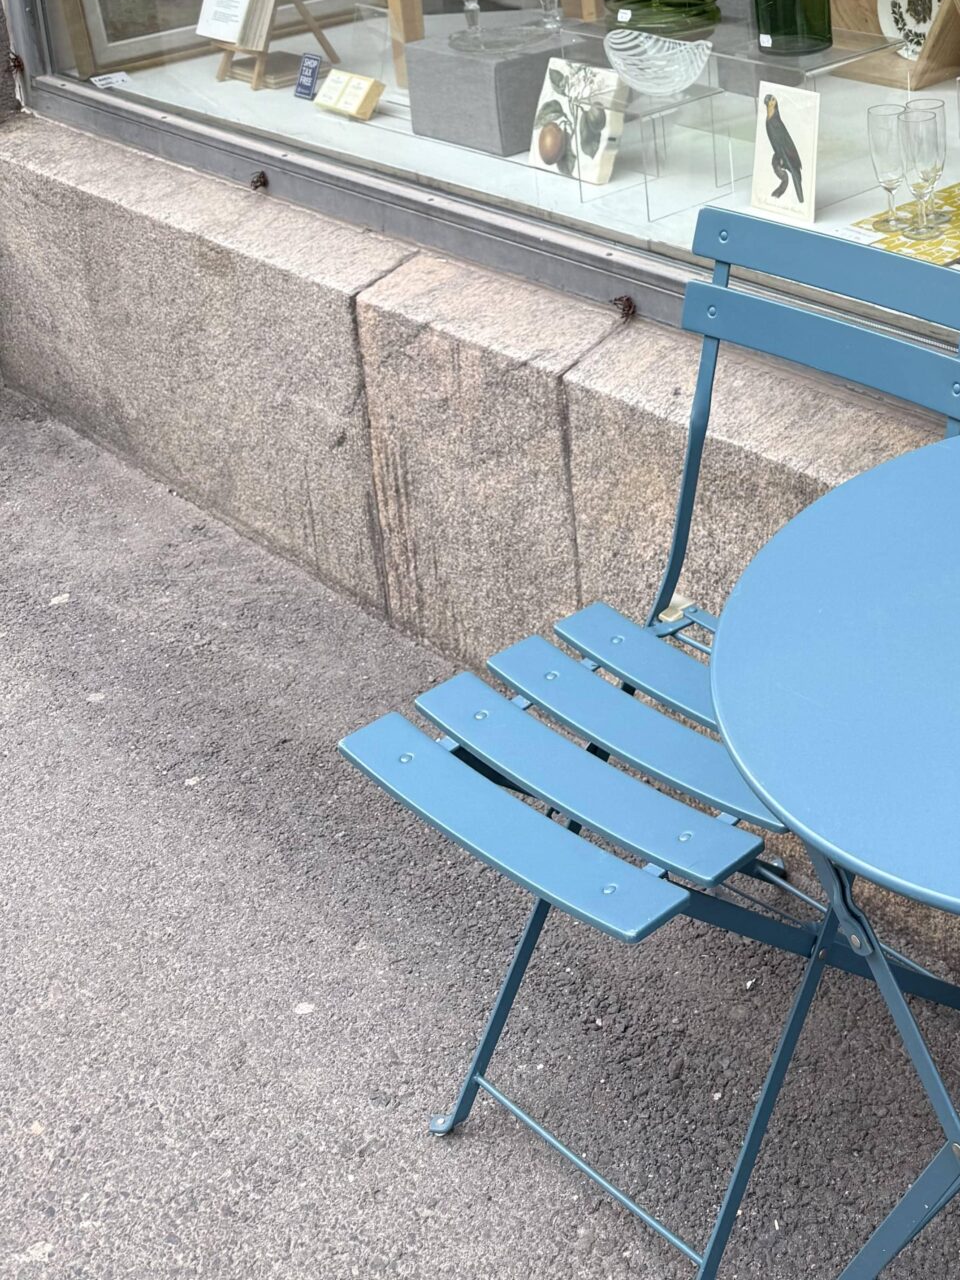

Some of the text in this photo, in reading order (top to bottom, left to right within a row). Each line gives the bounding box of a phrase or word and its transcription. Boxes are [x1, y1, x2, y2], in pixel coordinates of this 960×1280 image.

[304, 58, 318, 68] SHOP
[302, 66, 312, 77] TAX
[300, 75, 312, 86] FREE
